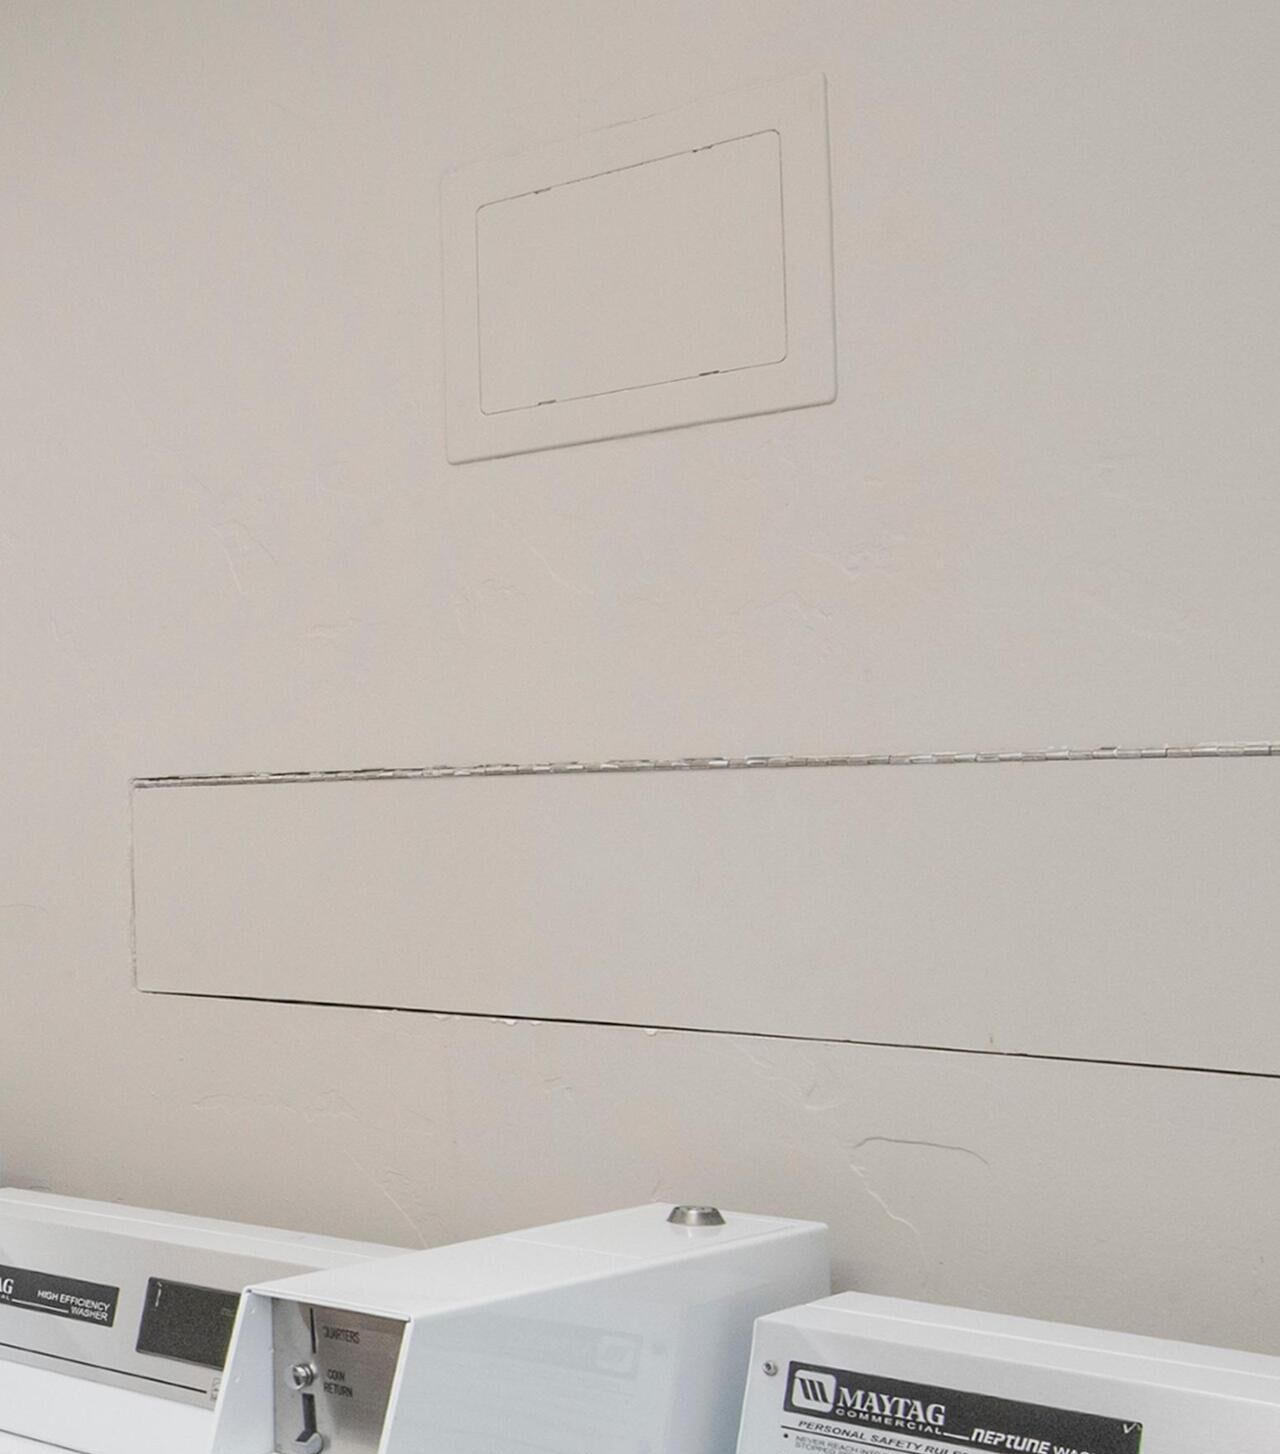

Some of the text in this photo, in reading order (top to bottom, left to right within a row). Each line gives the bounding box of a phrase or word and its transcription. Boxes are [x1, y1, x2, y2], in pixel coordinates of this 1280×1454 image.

[37, 1289, 112, 1312] HIGH EFFICIENCY
[70, 1305, 109, 1322] WASHER
[327, 1368, 346, 1382] COIN
[323, 1381, 353, 1398] RETURN
[838, 1386, 946, 1426] MAYTAG
[835, 1408, 945, 1435] COMMERCIAL
[795, 1435, 826, 1446] NEVER
[827, 1439, 857, 1453] REACH
[798, 1420, 866, 1441] PERSONAL
[870, 1435, 923, 1451] SAFETY
